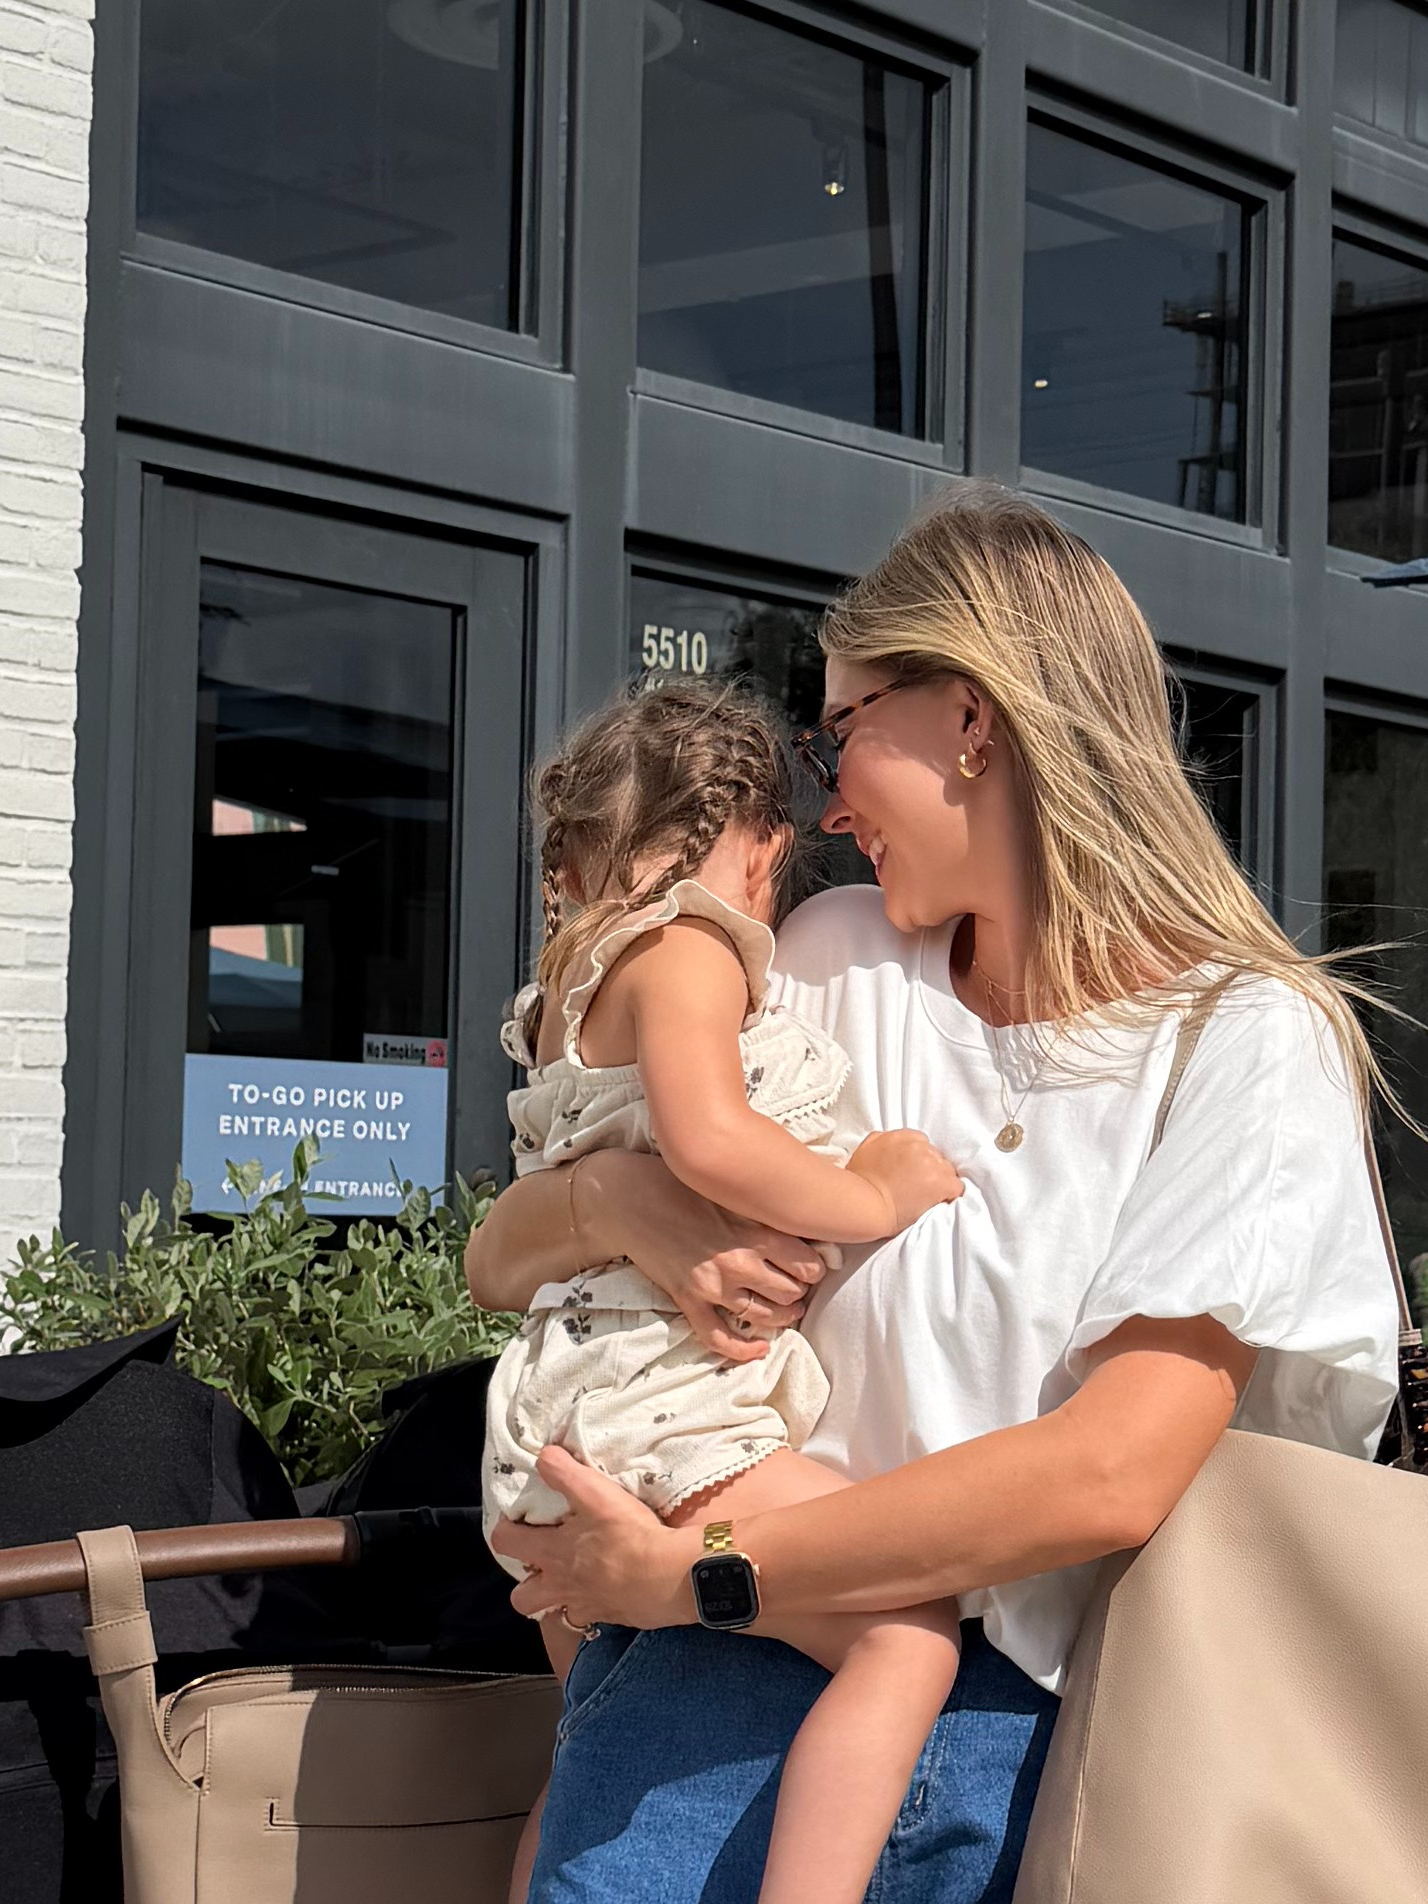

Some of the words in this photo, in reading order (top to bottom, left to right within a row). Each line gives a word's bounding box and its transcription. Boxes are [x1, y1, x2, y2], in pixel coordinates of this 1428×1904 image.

[641, 624, 708, 675] 5510
[366, 1041, 380, 1059] No
[228, 1083, 305, 1107] TO-GO
[313, 1088, 367, 1110] PICK
[375, 1091, 405, 1111] UP
[218, 1114, 345, 1139] ENTRANCE
[352, 1120, 411, 1141] ONLY
